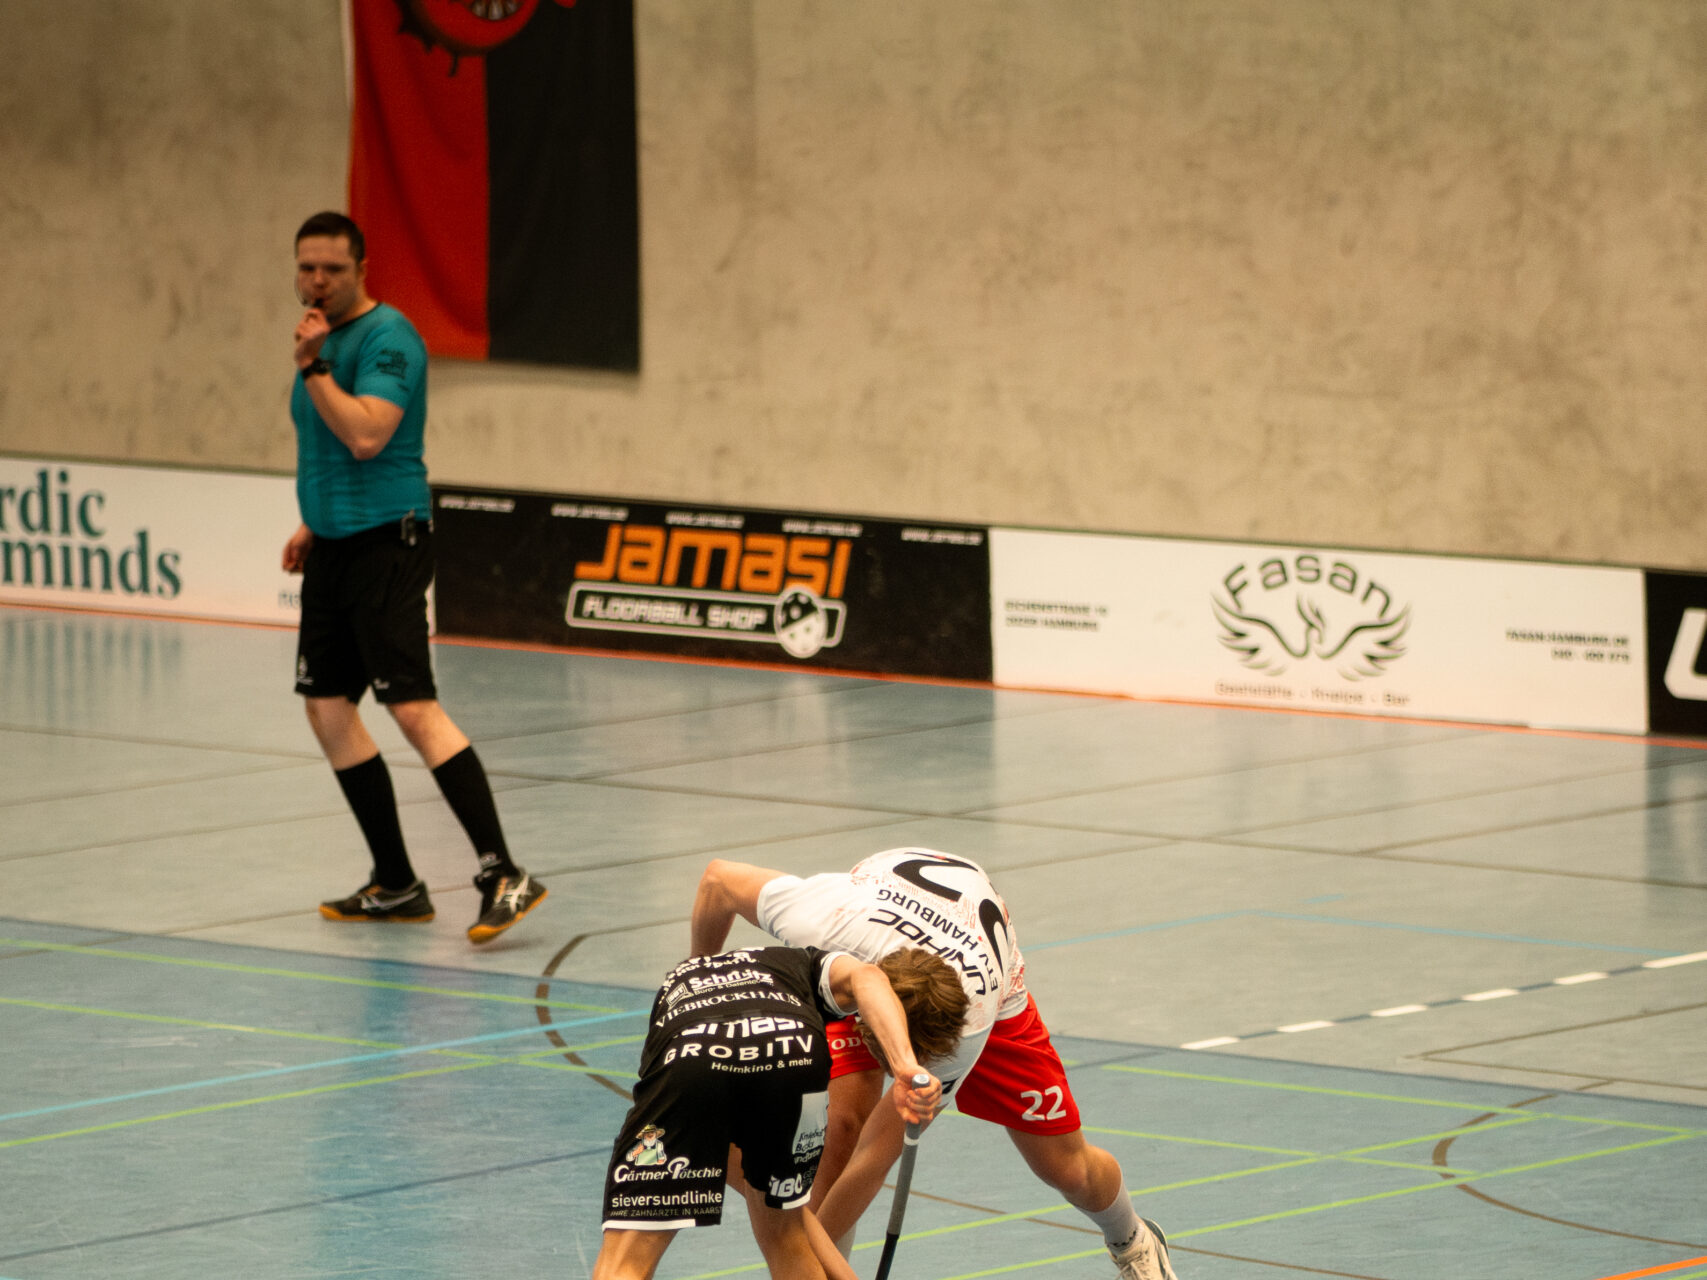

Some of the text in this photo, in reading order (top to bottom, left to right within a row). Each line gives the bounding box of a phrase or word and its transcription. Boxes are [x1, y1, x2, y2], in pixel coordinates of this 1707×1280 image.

[2, 528, 181, 598] minds
[1224, 555, 1391, 618] Fasan
[582, 595, 767, 631] FLOORBALL SHOP
[868, 908, 986, 996] UNIHOC
[876, 889, 998, 992] ETV HAMBURG
[656, 991, 802, 1028] VIEBROCKHAUS
[711, 1058, 813, 1074] Heimkino & mehr
[1021, 1085, 1067, 1121] 22
[614, 1164, 669, 1183] Gärtner
[612, 1190, 722, 1207] sieversundlinke
